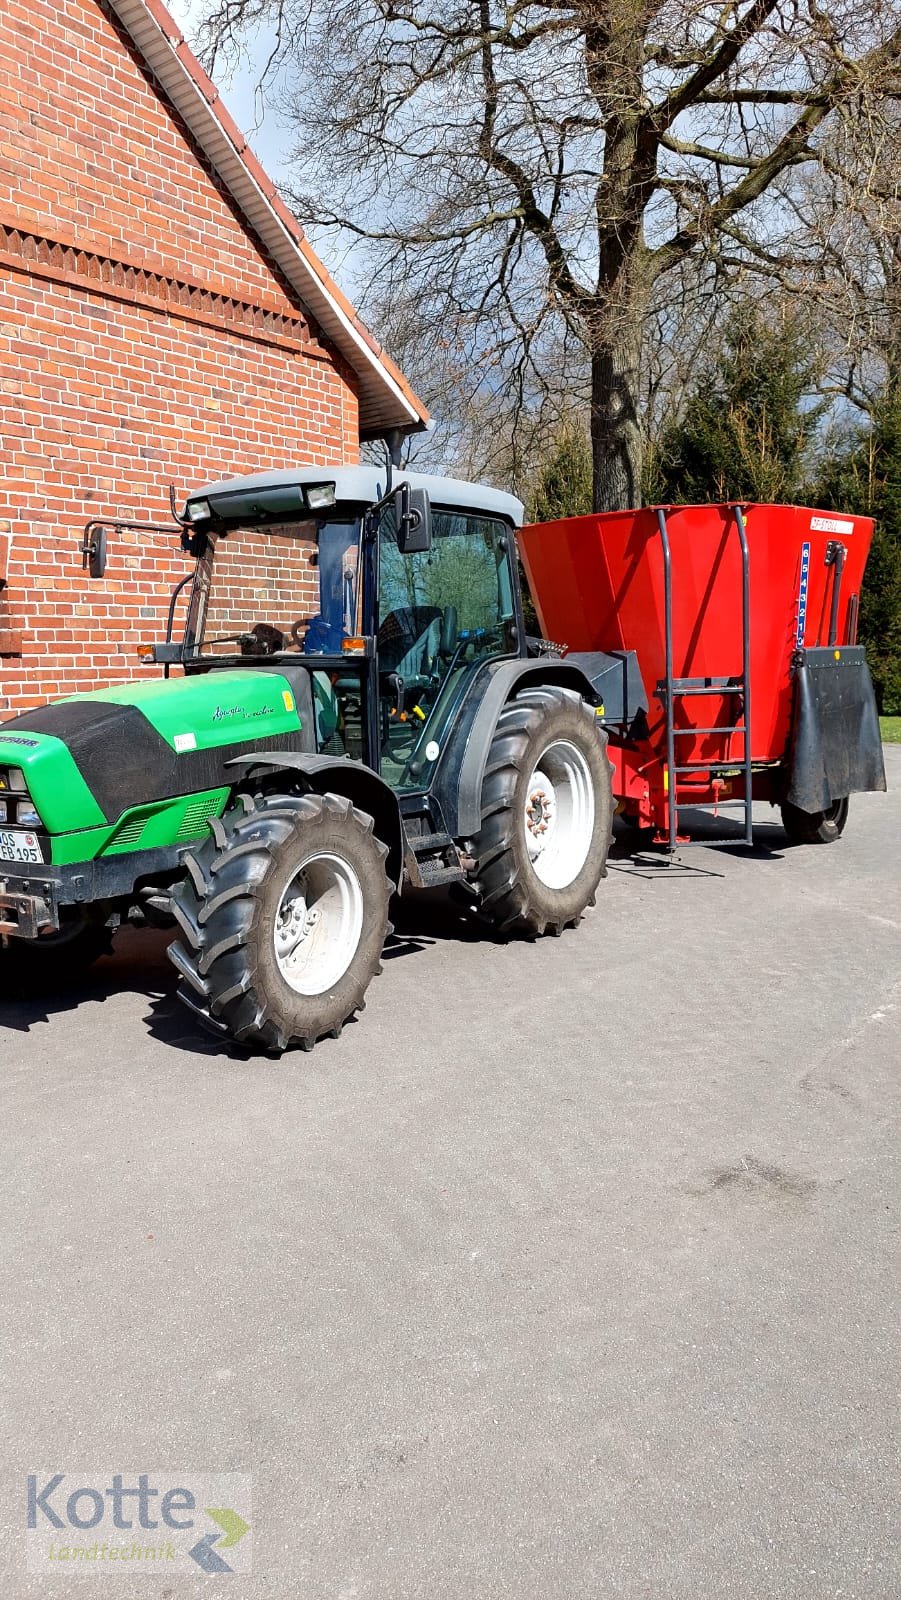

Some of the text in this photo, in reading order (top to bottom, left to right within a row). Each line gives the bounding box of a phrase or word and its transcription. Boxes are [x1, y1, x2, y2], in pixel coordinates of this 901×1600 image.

[803, 549, 809, 558] 6
[802, 564, 808, 573] 5
[801, 579, 807, 588] 4
[800, 594, 806, 602] 3
[799, 608, 805, 617] 2
[798, 623, 803, 631] 1
[2, 833, 15, 847] OS
[17, 848, 38, 862] 195
